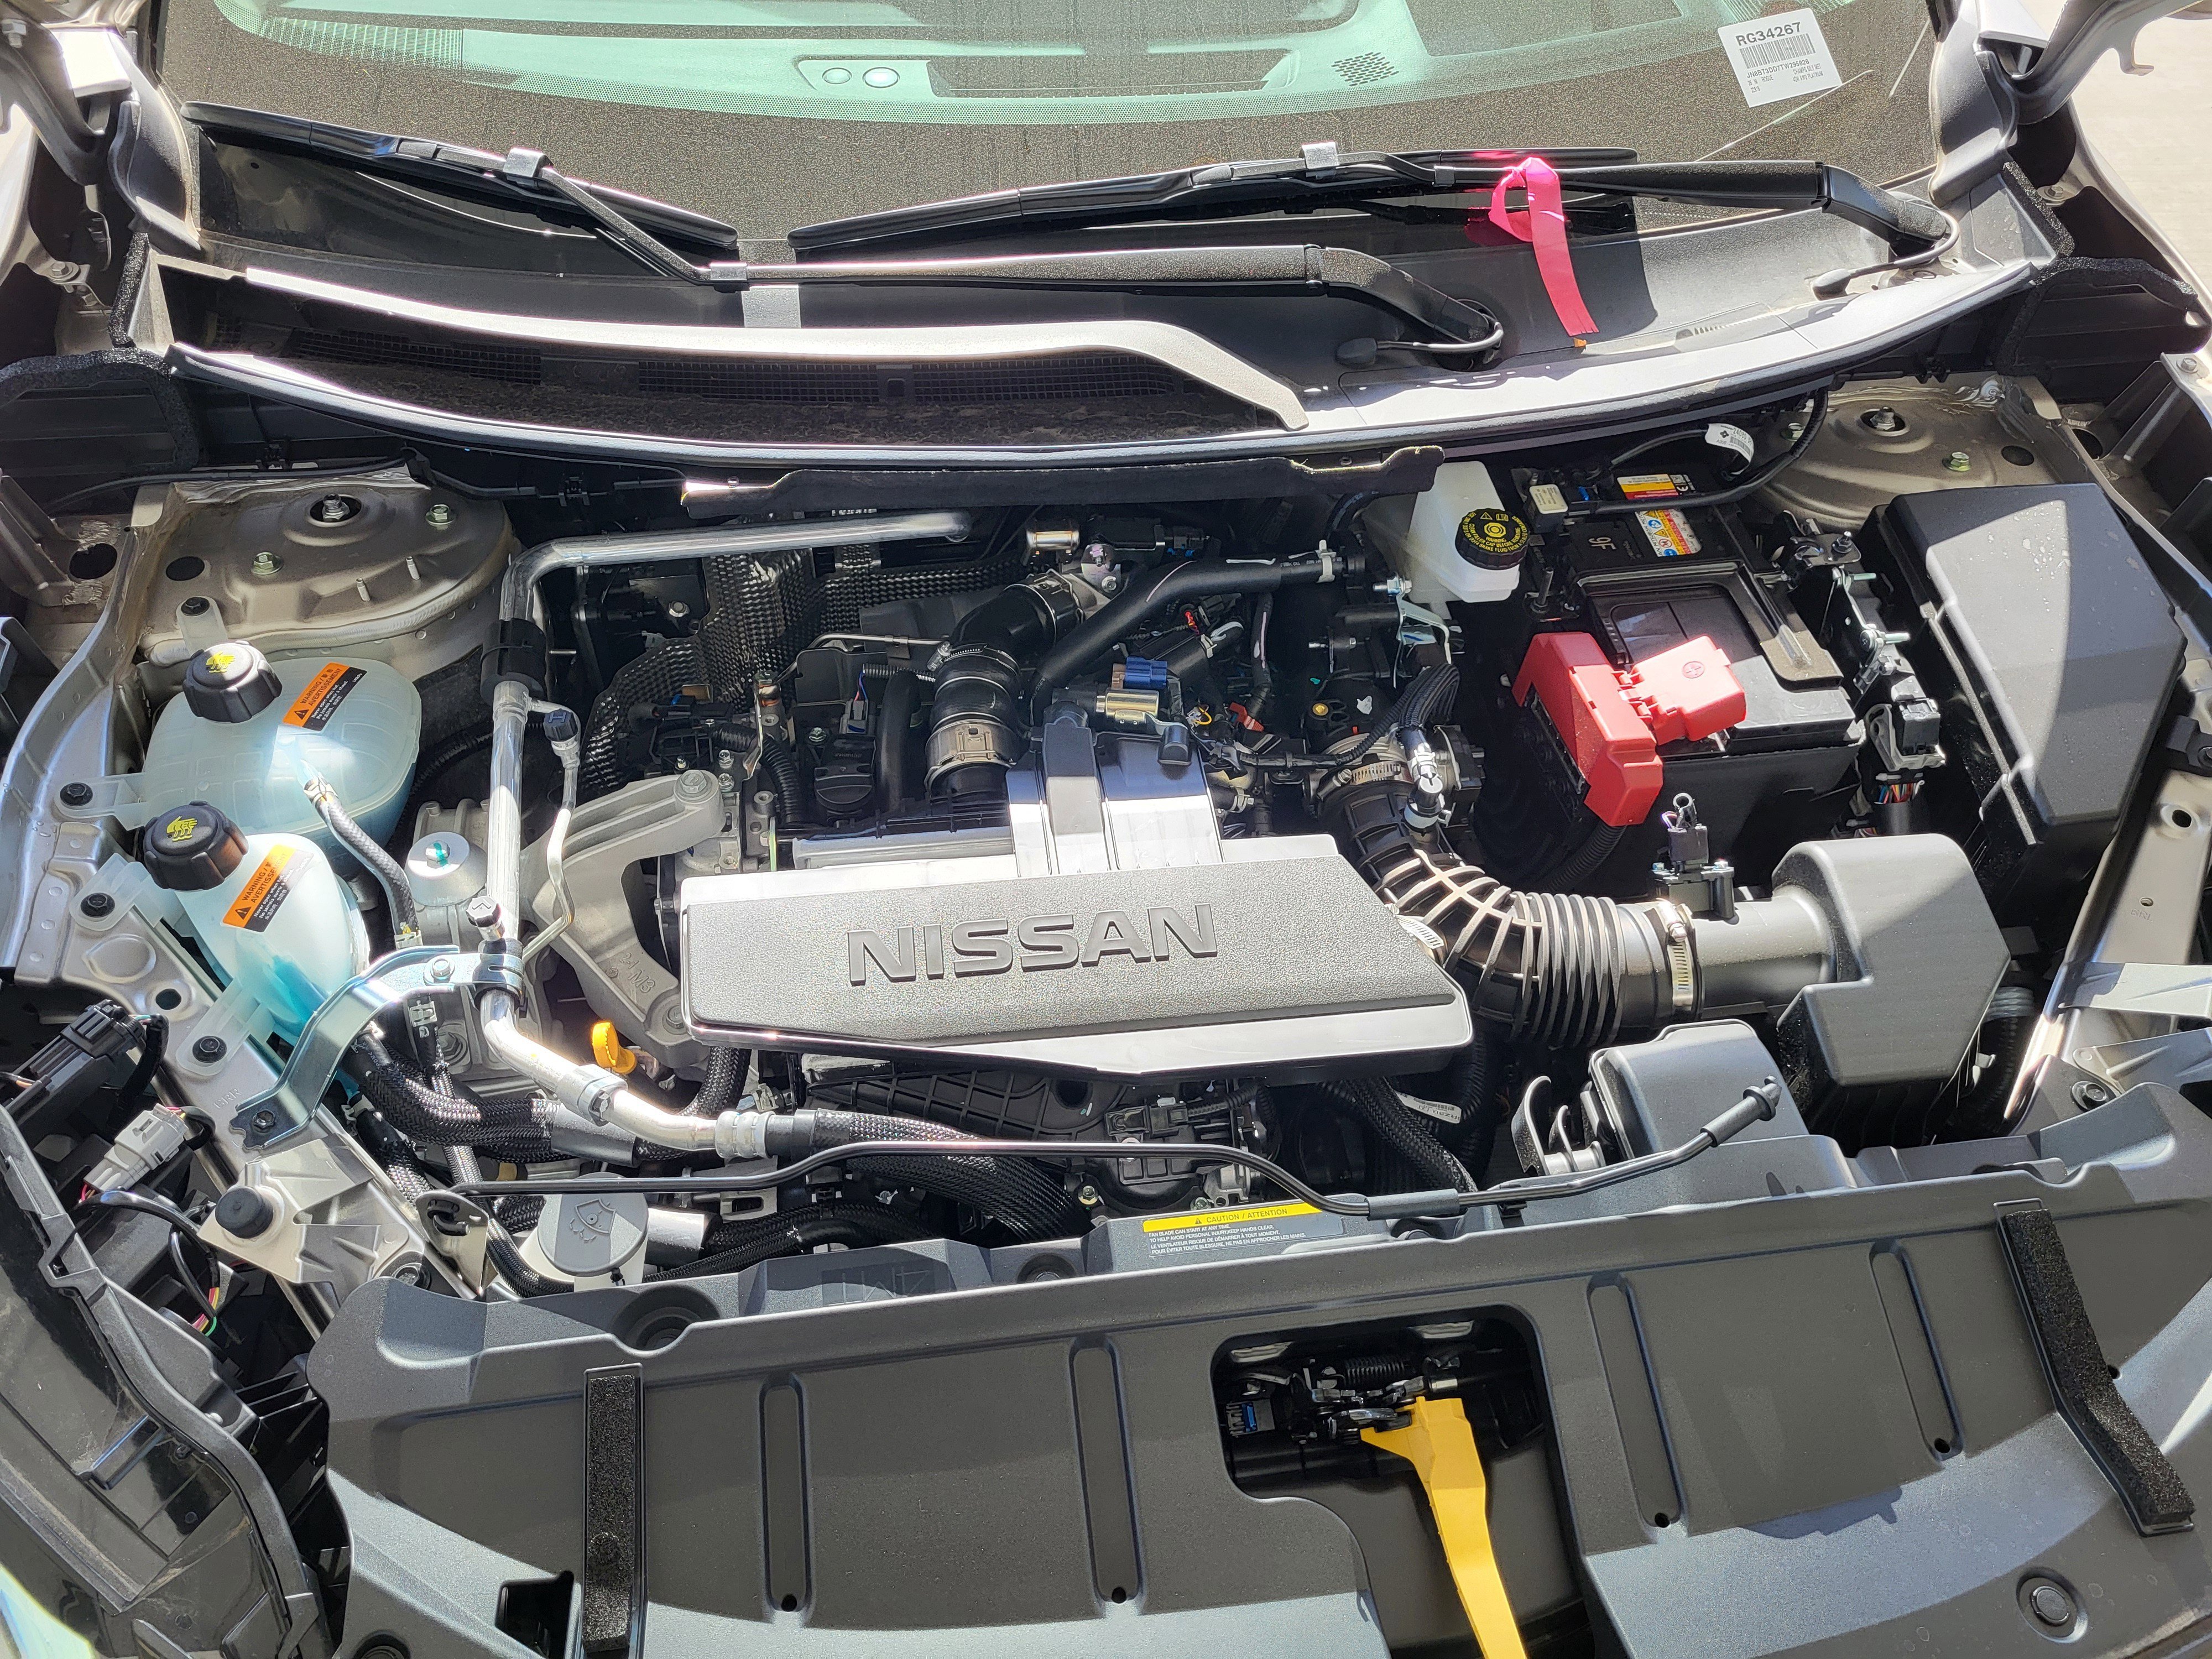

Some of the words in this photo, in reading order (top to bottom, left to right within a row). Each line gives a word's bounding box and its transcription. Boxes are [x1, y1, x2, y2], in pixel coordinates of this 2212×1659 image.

[1735, 22, 1801, 46] RG34267
[300, 681, 322, 704] WARNING
[309, 668, 342, 706] AVERTISSEMENT
[242, 872, 266, 901] WARNING
[251, 853, 288, 904] AVERTISSEMENT
[253, 904, 264, 917] Never
[263, 894, 272, 905] open
[270, 883, 279, 894] when
[847, 903, 1217, 987] NISSAN
[628, 969, 655, 993] M3
[1206, 1214, 1240, 1223] CAUTION
[1248, 1208, 1287, 1219] ATTENTION
[1157, 1240, 1188, 1249] VENTILATEUR
[1166, 1245, 1182, 1254] ÉVITER
